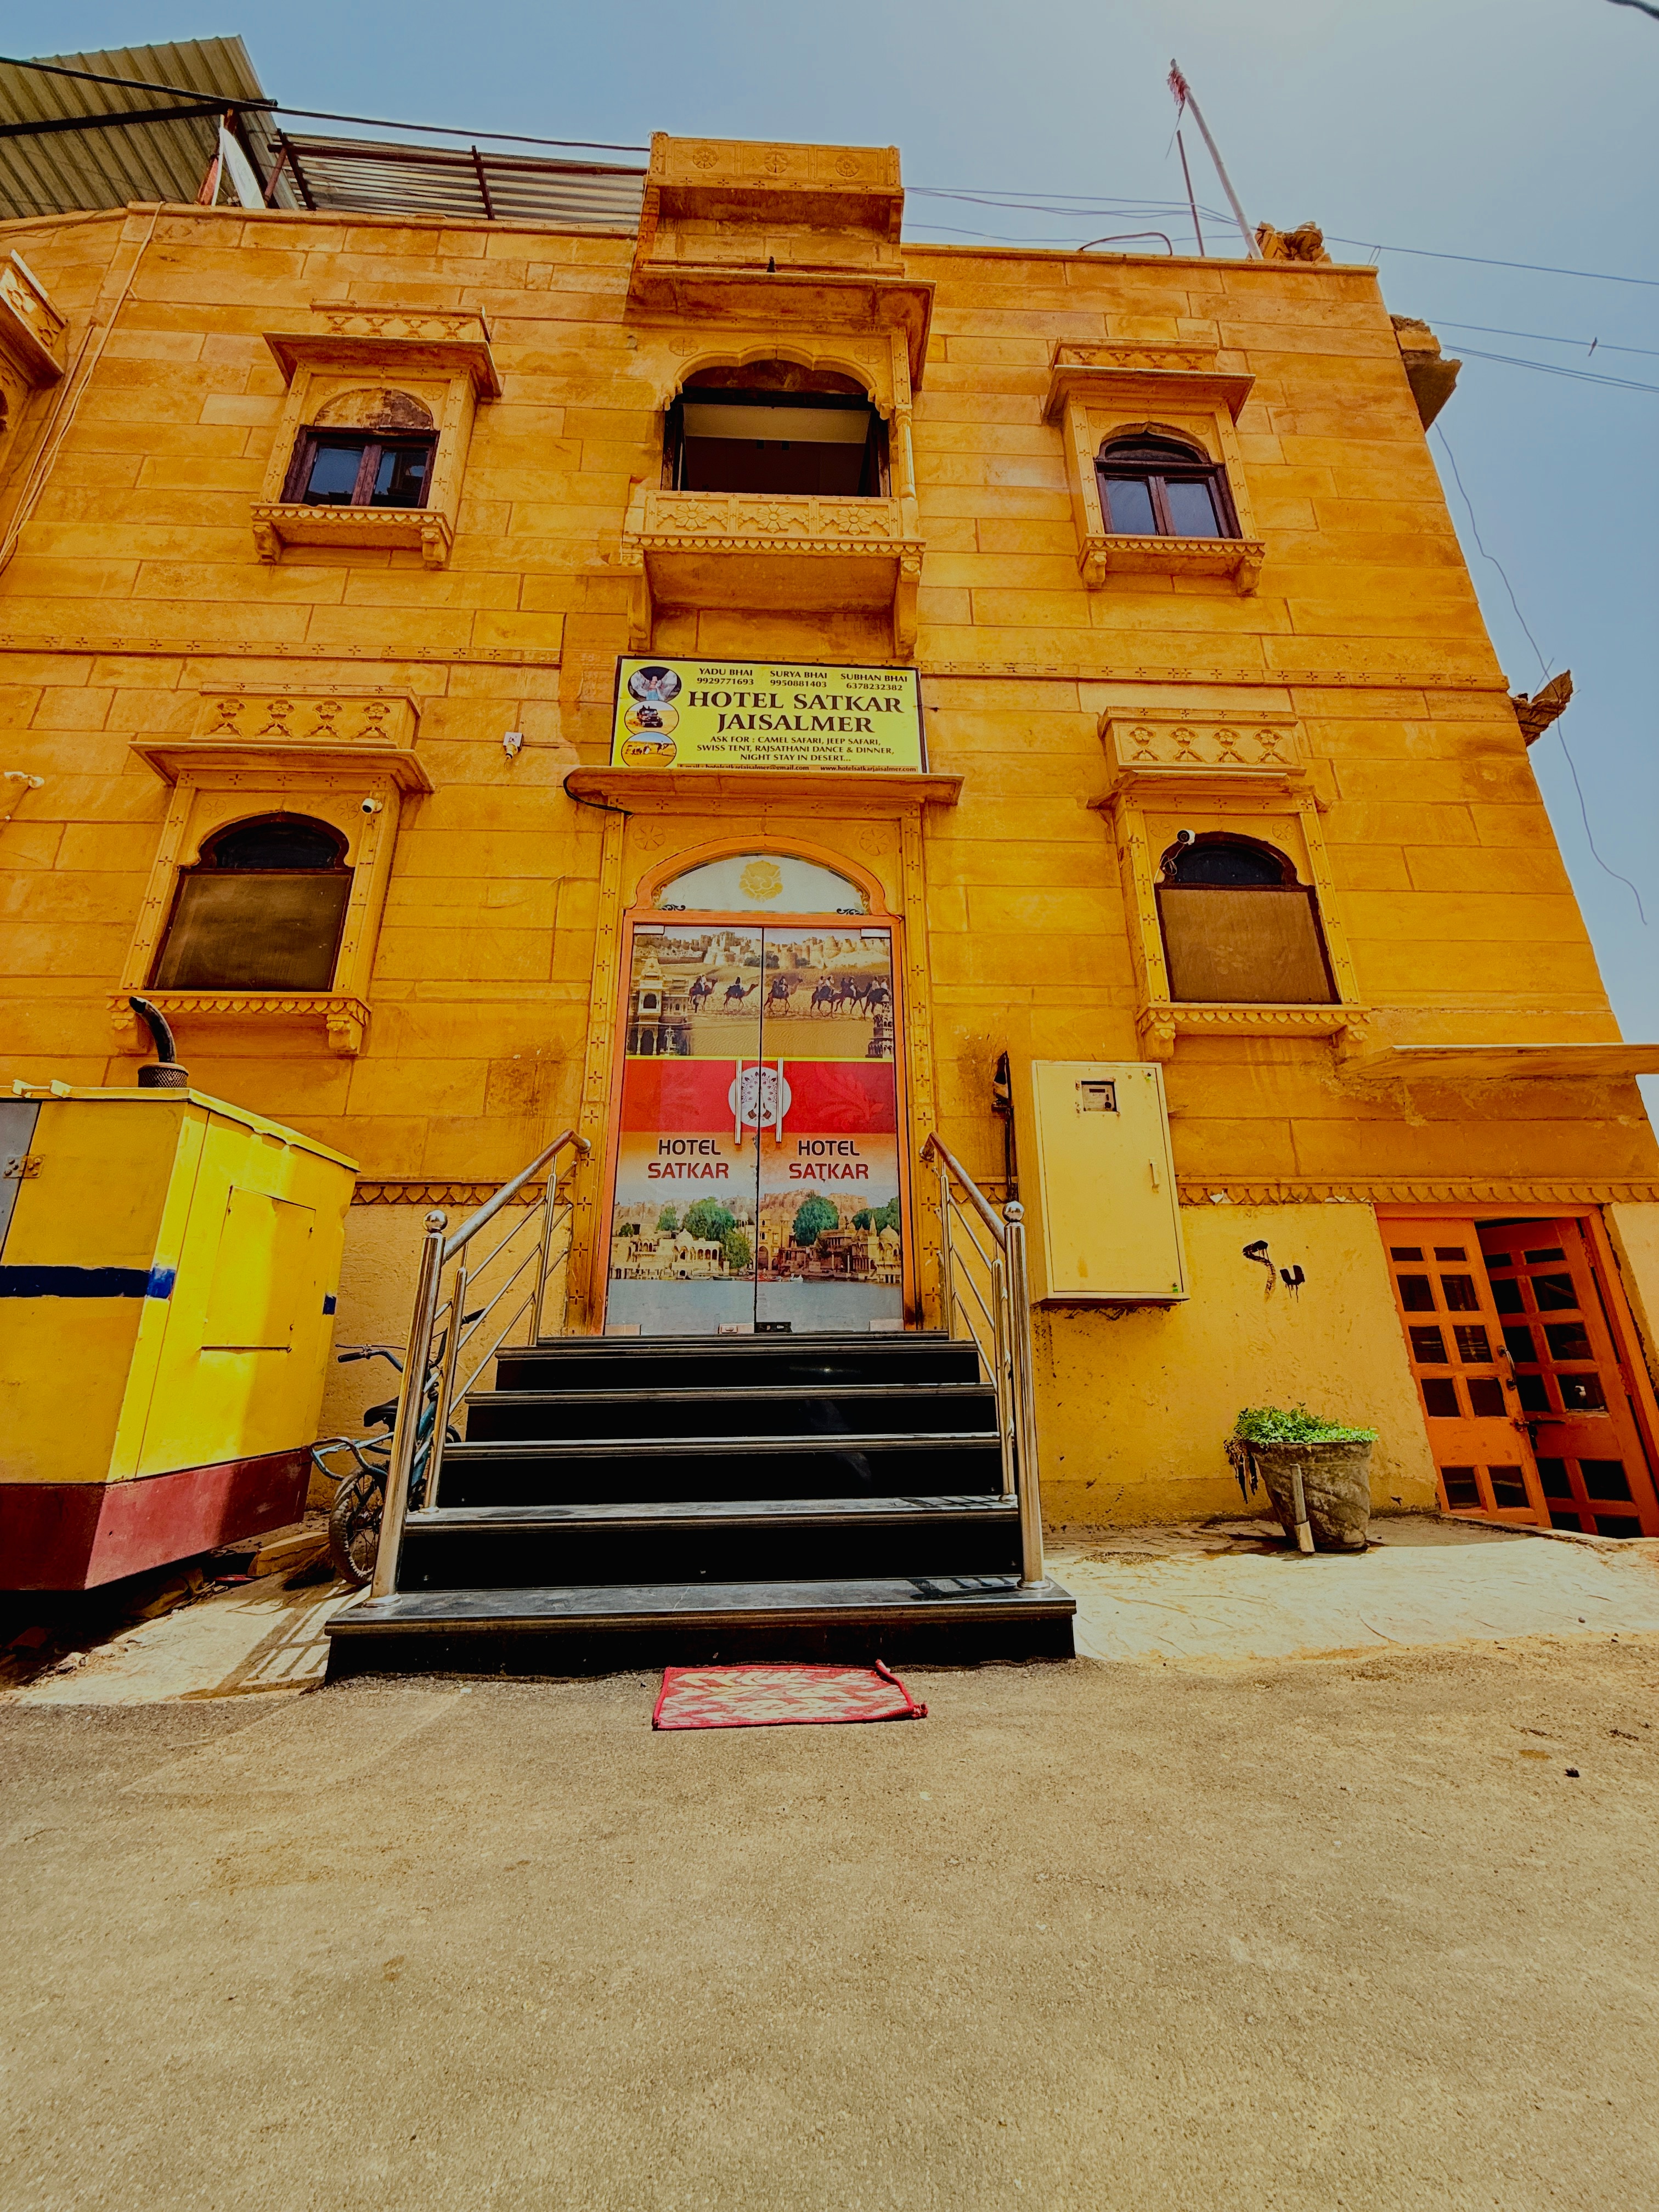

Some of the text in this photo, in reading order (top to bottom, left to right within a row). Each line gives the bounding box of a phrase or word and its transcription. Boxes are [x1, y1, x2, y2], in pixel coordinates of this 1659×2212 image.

[770, 679, 827, 687] 9950881403
[846, 682, 902, 691] 6378232382
[687, 691, 905, 713] HOTEL SATKAR
[717, 714, 876, 733] JAISALMER
[856, 747, 894, 755] DINNER,
[658, 1139, 721, 1155] HOTEL
[798, 1140, 860, 1156] HOTEL
[647, 1163, 729, 1179] SATKAR
[789, 1163, 869, 1180] SATKAR
